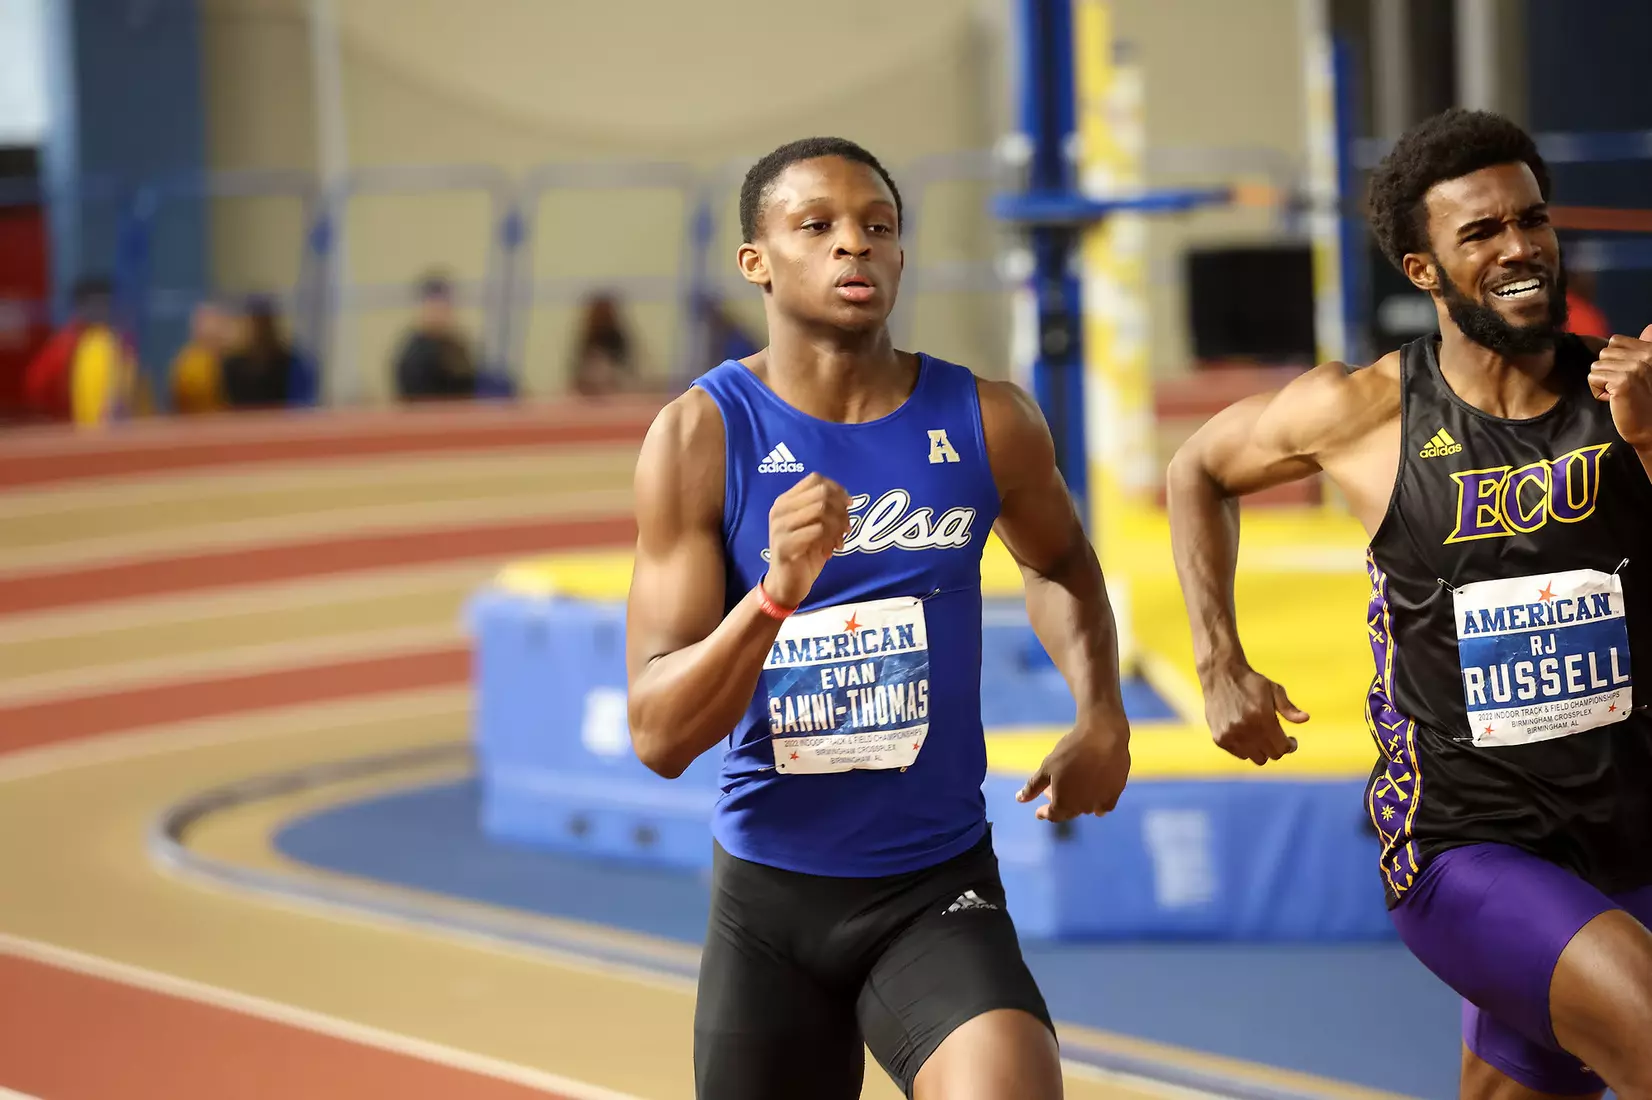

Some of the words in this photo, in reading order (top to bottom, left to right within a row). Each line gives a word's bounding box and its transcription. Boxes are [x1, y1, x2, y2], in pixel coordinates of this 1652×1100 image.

[927, 429, 961, 464] A
[1419, 442, 1463, 459] adidas
[757, 461, 805, 474] adidas
[1442, 442, 1613, 545] ECU
[1463, 592, 1613, 635] AMERICAN
[770, 623, 917, 665] AMERICAN
[1529, 633, 1558, 657] RJ
[820, 662, 876, 690] EVAN
[1463, 647, 1629, 706] RUSSELL
[769, 679, 929, 735] SANNI-THOMAS
[1478, 713, 1493, 722] 2022
[1494, 710, 1520, 720] INDOOR
[1521, 707, 1543, 717] TRACK
[1544, 706, 1550, 714] &
[1550, 703, 1570, 713] FIELD
[1570, 690, 1620, 711] CHAMPIONSHIPS
[1511, 716, 1554, 728] BIRMINGHAM
[1555, 708, 1593, 721] CROSSPLEX
[784, 739, 799, 747] 2022
